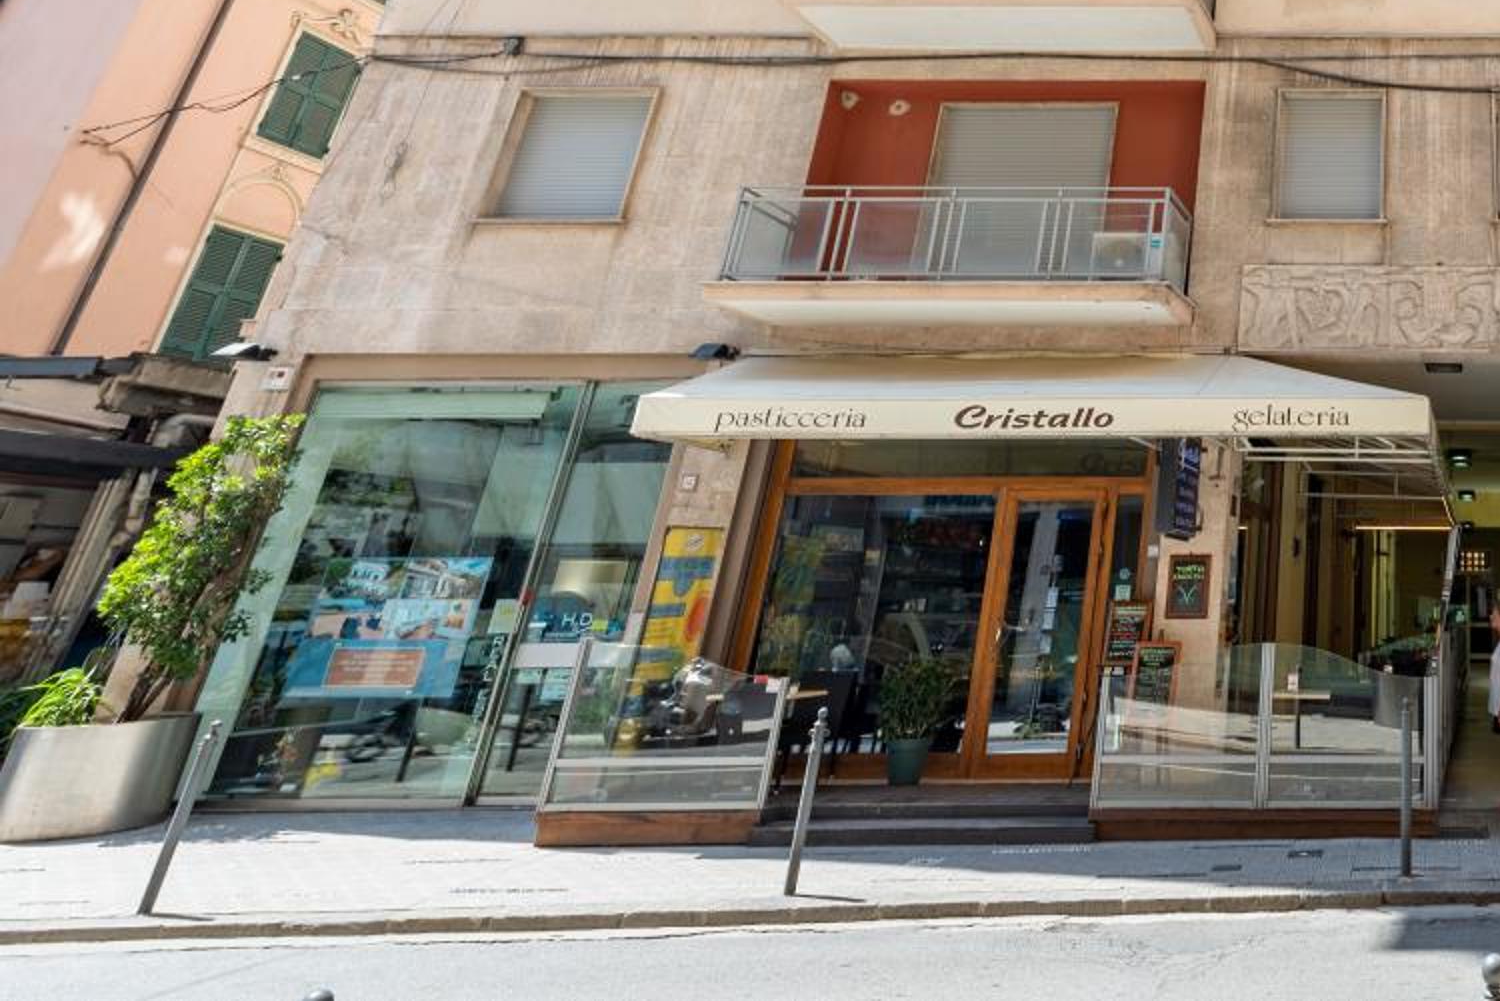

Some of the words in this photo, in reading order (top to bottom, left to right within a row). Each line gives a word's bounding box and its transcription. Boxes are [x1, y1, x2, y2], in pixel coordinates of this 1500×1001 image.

[714, 407, 866, 433] pasticceria
[954, 405, 1114, 429] Cristallo
[1232, 404, 1350, 432] gelateria
